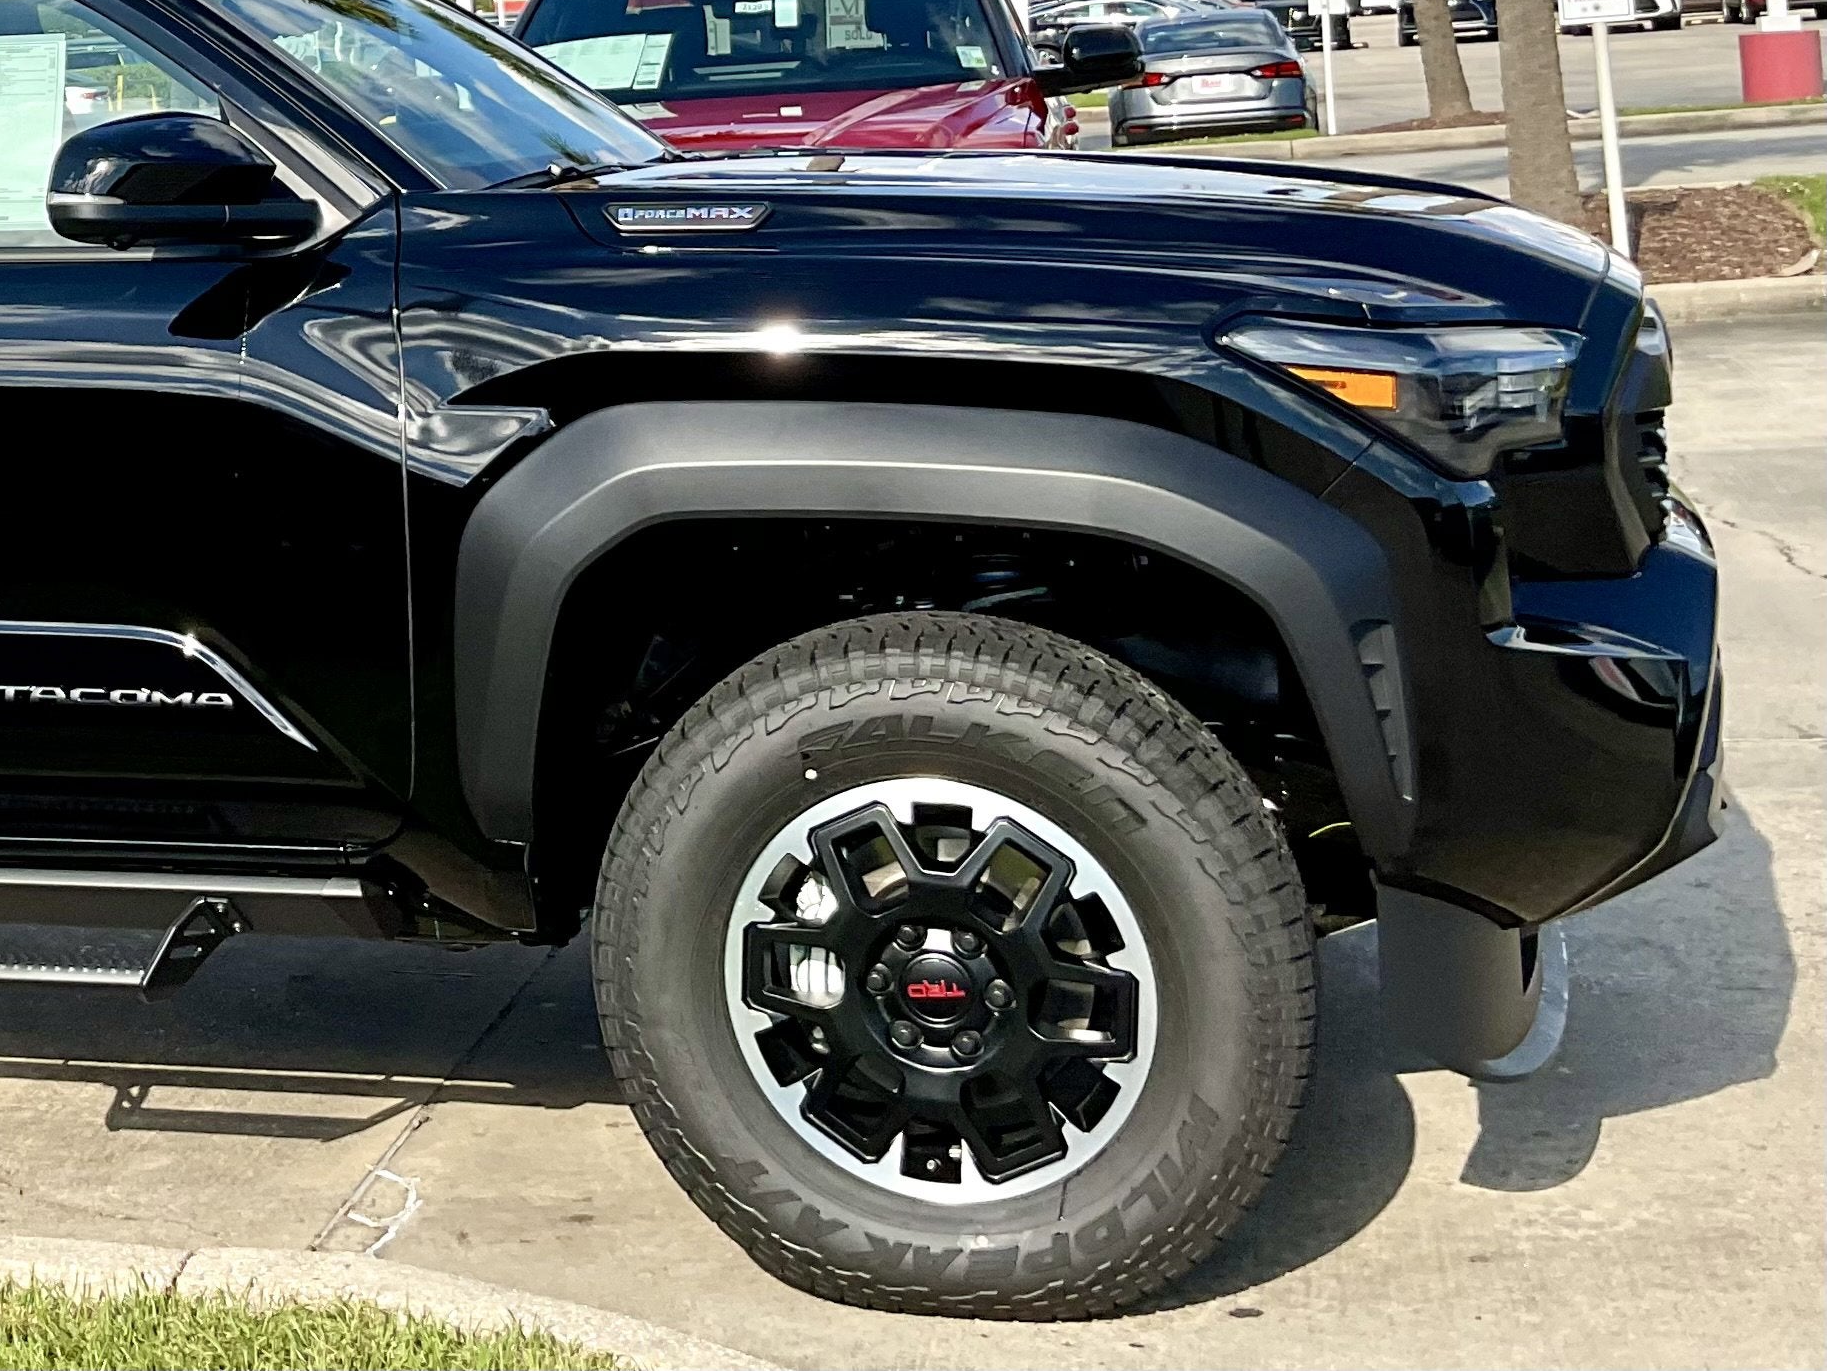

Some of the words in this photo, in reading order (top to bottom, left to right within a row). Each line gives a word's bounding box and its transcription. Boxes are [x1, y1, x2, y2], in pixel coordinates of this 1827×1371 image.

[844, 30, 872, 41] SOLD
[798, 714, 1148, 832] FALKEN
[907, 980, 966, 998] TRD
[858, 1092, 1220, 1279] WILDPEAK
